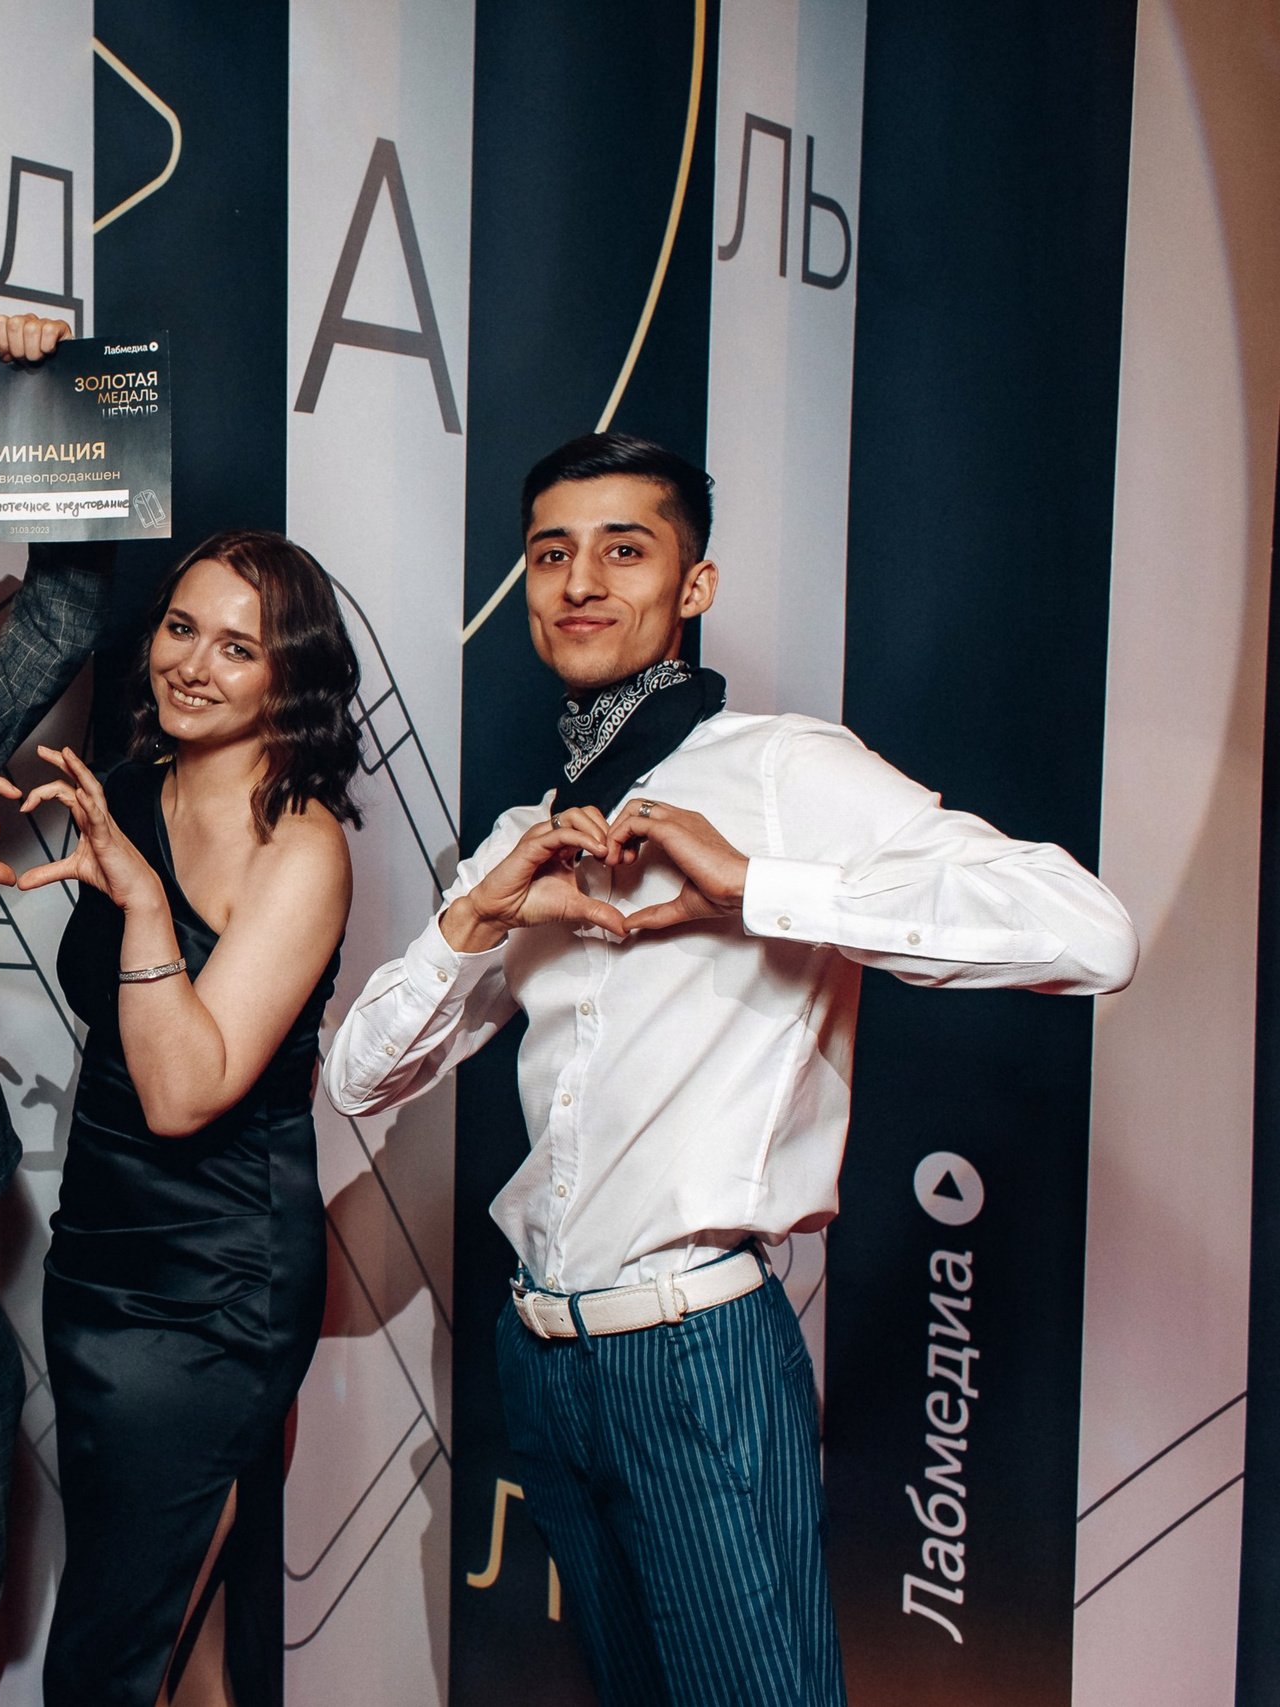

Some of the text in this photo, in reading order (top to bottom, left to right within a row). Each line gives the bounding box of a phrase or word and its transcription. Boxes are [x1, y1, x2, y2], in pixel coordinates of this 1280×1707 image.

[104, 345, 148, 355] Лабмедиа
[75, 371, 158, 392] ЗОЛОТАЯ
[97, 389, 158, 404] МЕДАЛЬ
[0, 470, 120, 484] видеопродакшен
[56, 498, 131, 517] кредитование
[10, 526, 50, 535] 31.03.2023
[902, 1250, 980, 1645] Лабмедиа
